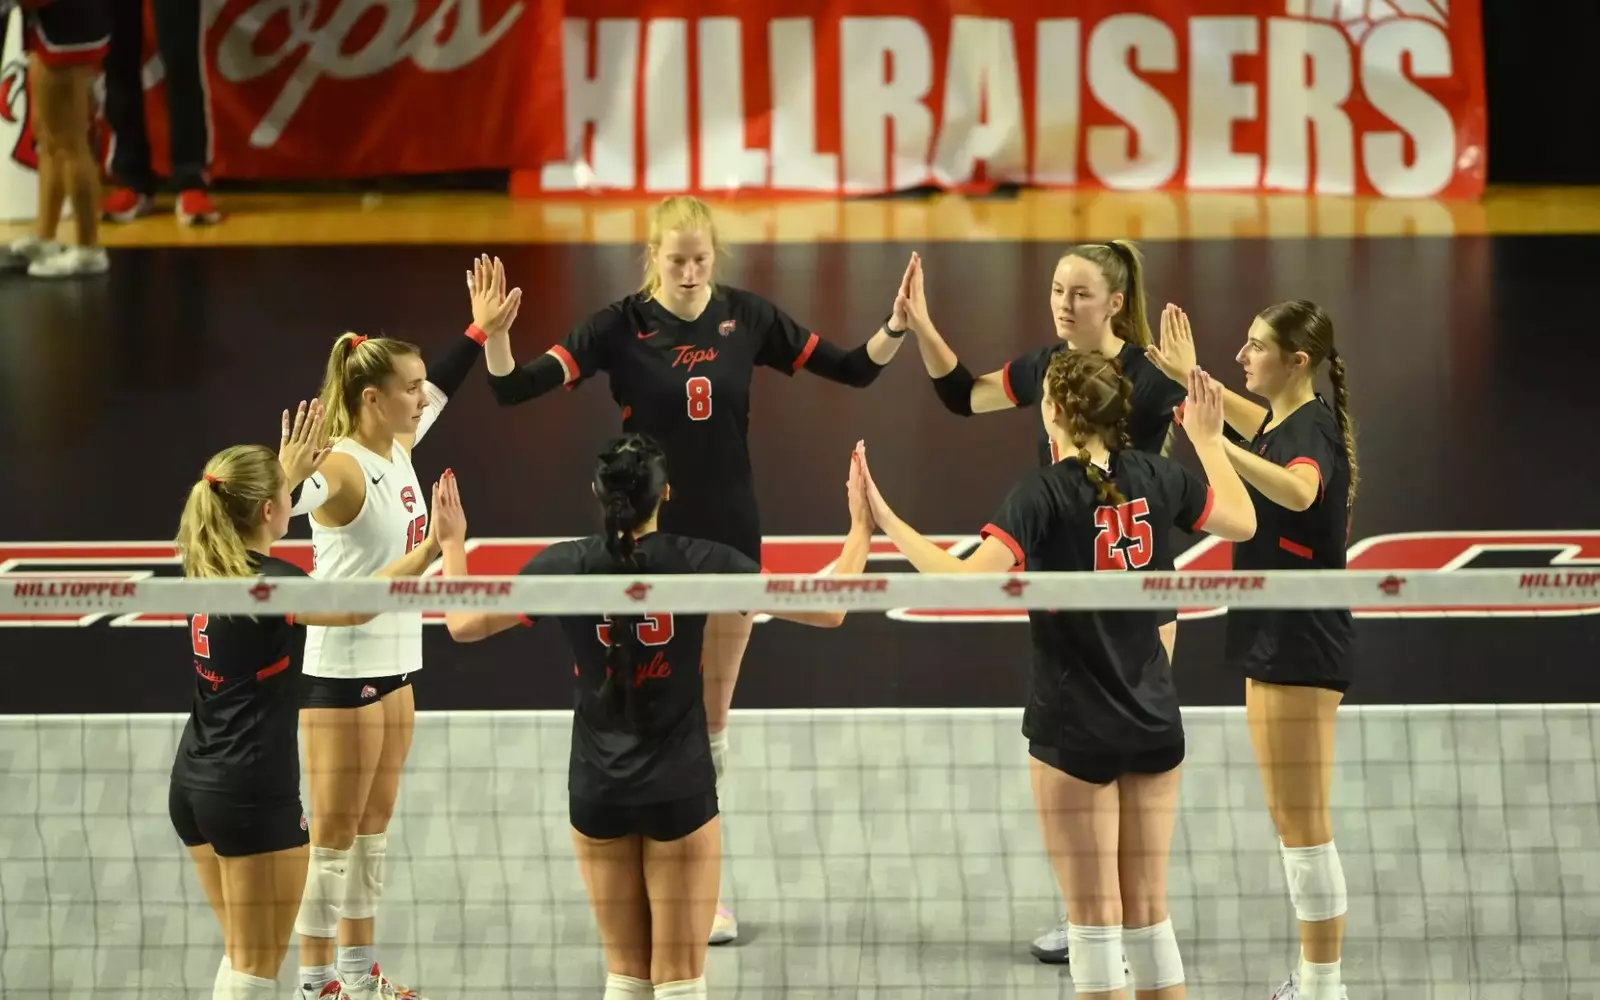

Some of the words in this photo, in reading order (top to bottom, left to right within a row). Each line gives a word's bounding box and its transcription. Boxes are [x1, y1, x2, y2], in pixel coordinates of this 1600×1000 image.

[145, 0, 527, 147] ops
[541, 17, 1456, 198] HILLRAISERS
[671, 344, 719, 372] Tops
[686, 376, 712, 420] 8
[405, 514, 427, 555] 15
[1094, 497, 1153, 572] 25
[14, 582, 136, 597] HILLTOPPER
[389, 581, 513, 596] HILLTOPPER
[766, 579, 888, 594] HILLTOPPER
[1142, 576, 1265, 591] HILLTOPPER
[192, 612, 210, 658] 2
